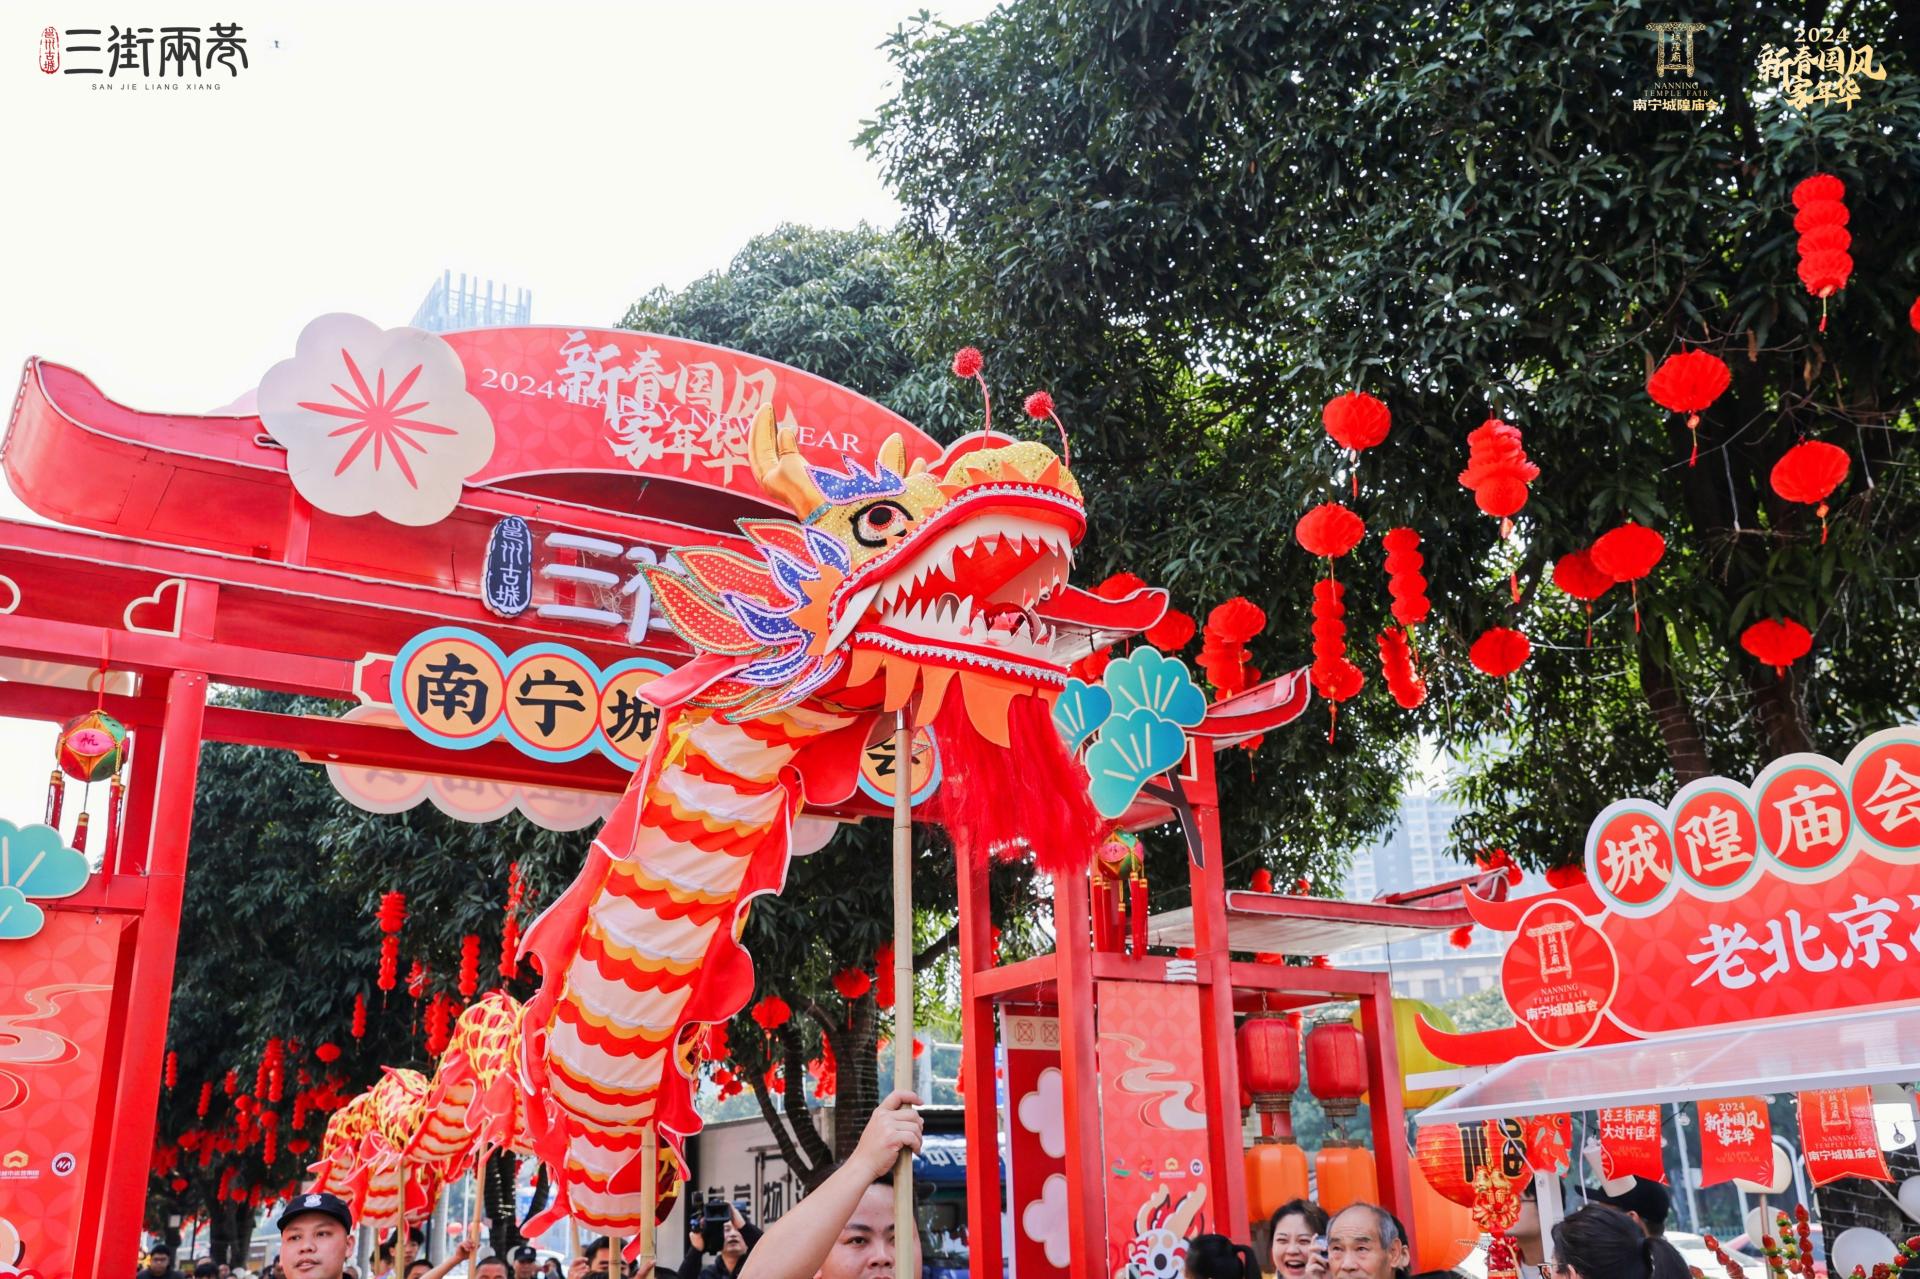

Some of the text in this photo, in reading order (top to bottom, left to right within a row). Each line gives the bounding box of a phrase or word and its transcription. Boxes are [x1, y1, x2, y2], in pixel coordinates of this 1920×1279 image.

[480, 368, 555, 400] 2024
[776, 421, 863, 454] EAR
[1601, 758, 1920, 894] 城隍庙会
[1686, 893, 1920, 989] 老北京
[1541, 983, 1578, 995] NANNING
[1526, 998, 1598, 1021] 南宁城隍庙会
[1719, 1102, 1745, 1111] 2024
[1602, 1124, 1657, 1141] 大过中国年
[1807, 1148, 1877, 1161] 南宁城隍庙会
